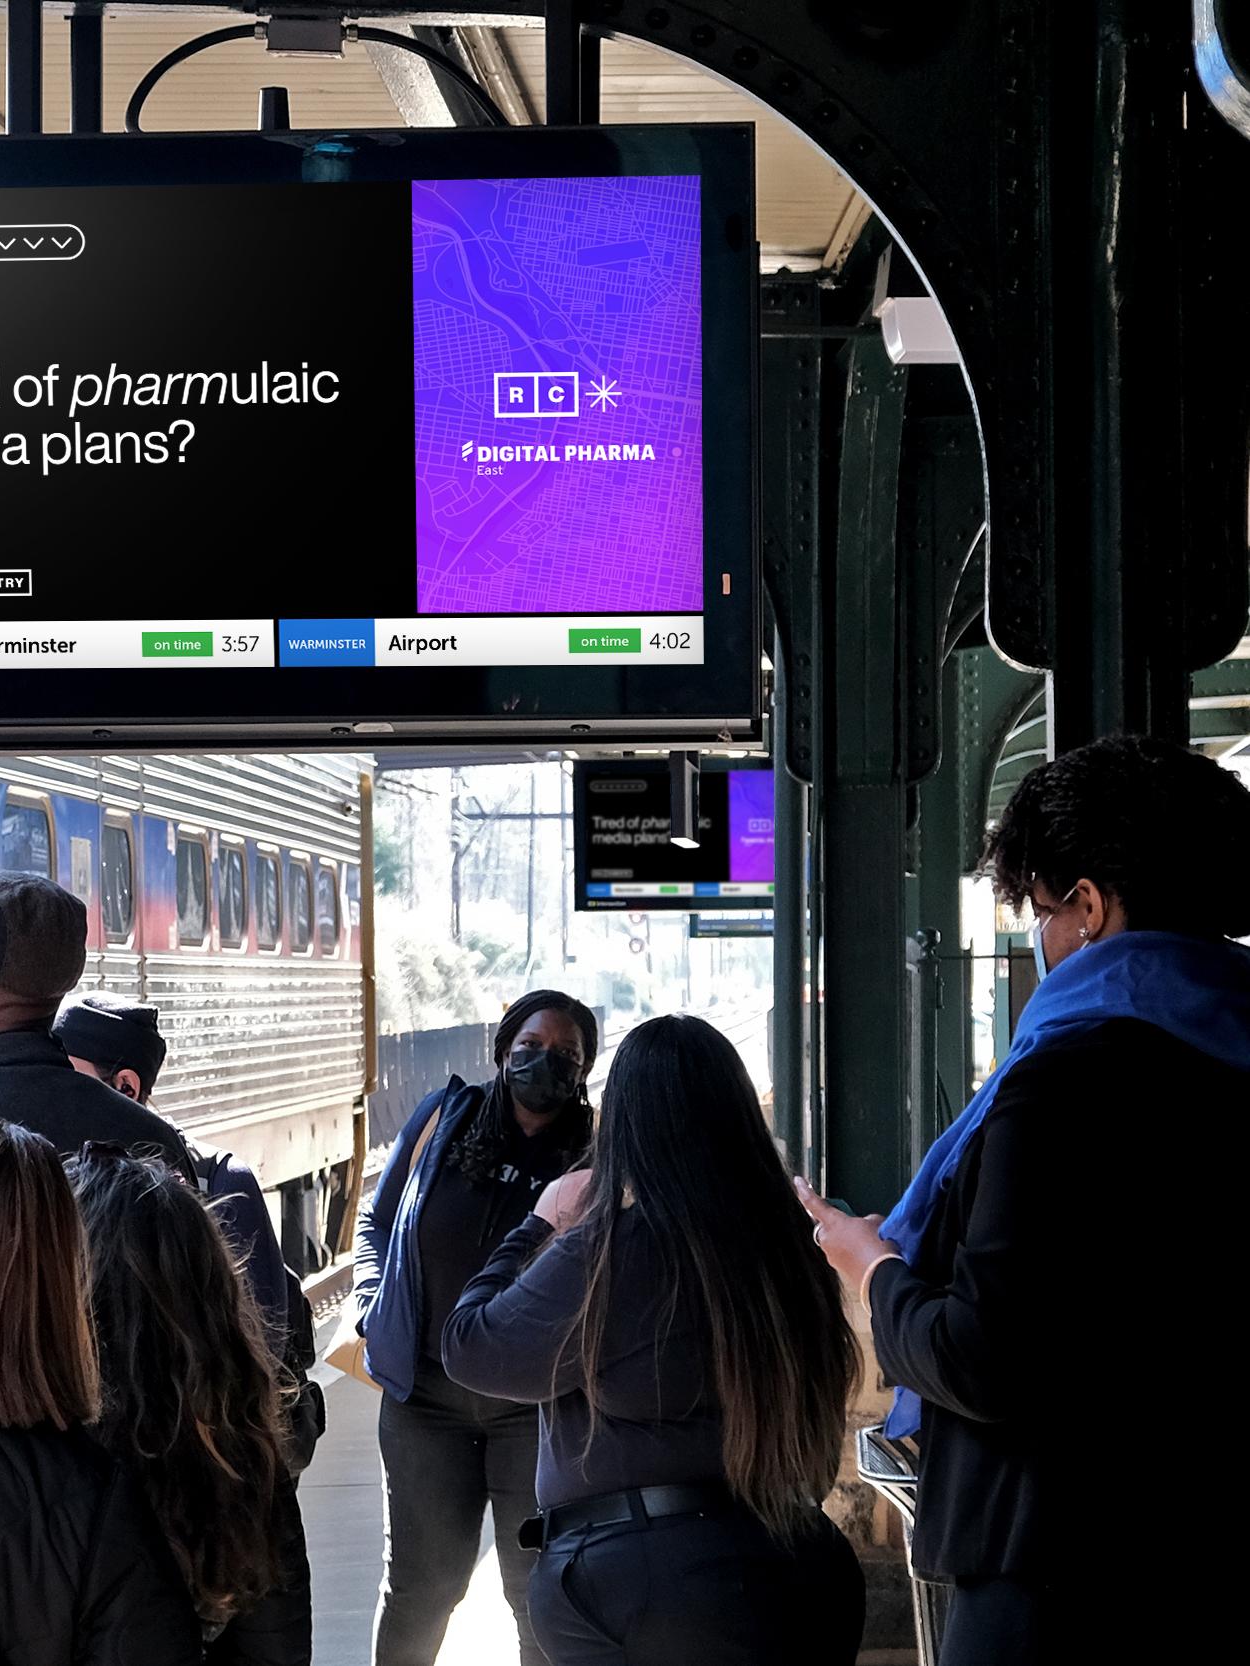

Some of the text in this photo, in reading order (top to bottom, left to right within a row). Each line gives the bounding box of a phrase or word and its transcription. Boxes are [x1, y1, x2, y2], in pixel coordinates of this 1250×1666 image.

[13, 363, 60, 408] of
[68, 360, 340, 417] pharmulaic
[509, 385, 565, 403] R C
[42, 419, 196, 476] plans?
[477, 444, 656, 462] DIGITAL PHARMA
[476, 465, 504, 476] East
[154, 639, 202, 651] on time
[221, 635, 261, 653] 3:57
[288, 638, 366, 650] WARMINSTER
[388, 634, 458, 655] Airport
[581, 635, 630, 648] on time
[649, 632, 691, 651] 4:02
[592, 815, 626, 829] Tired
[627, 815, 640, 829] of
[592, 831, 631, 844] media
